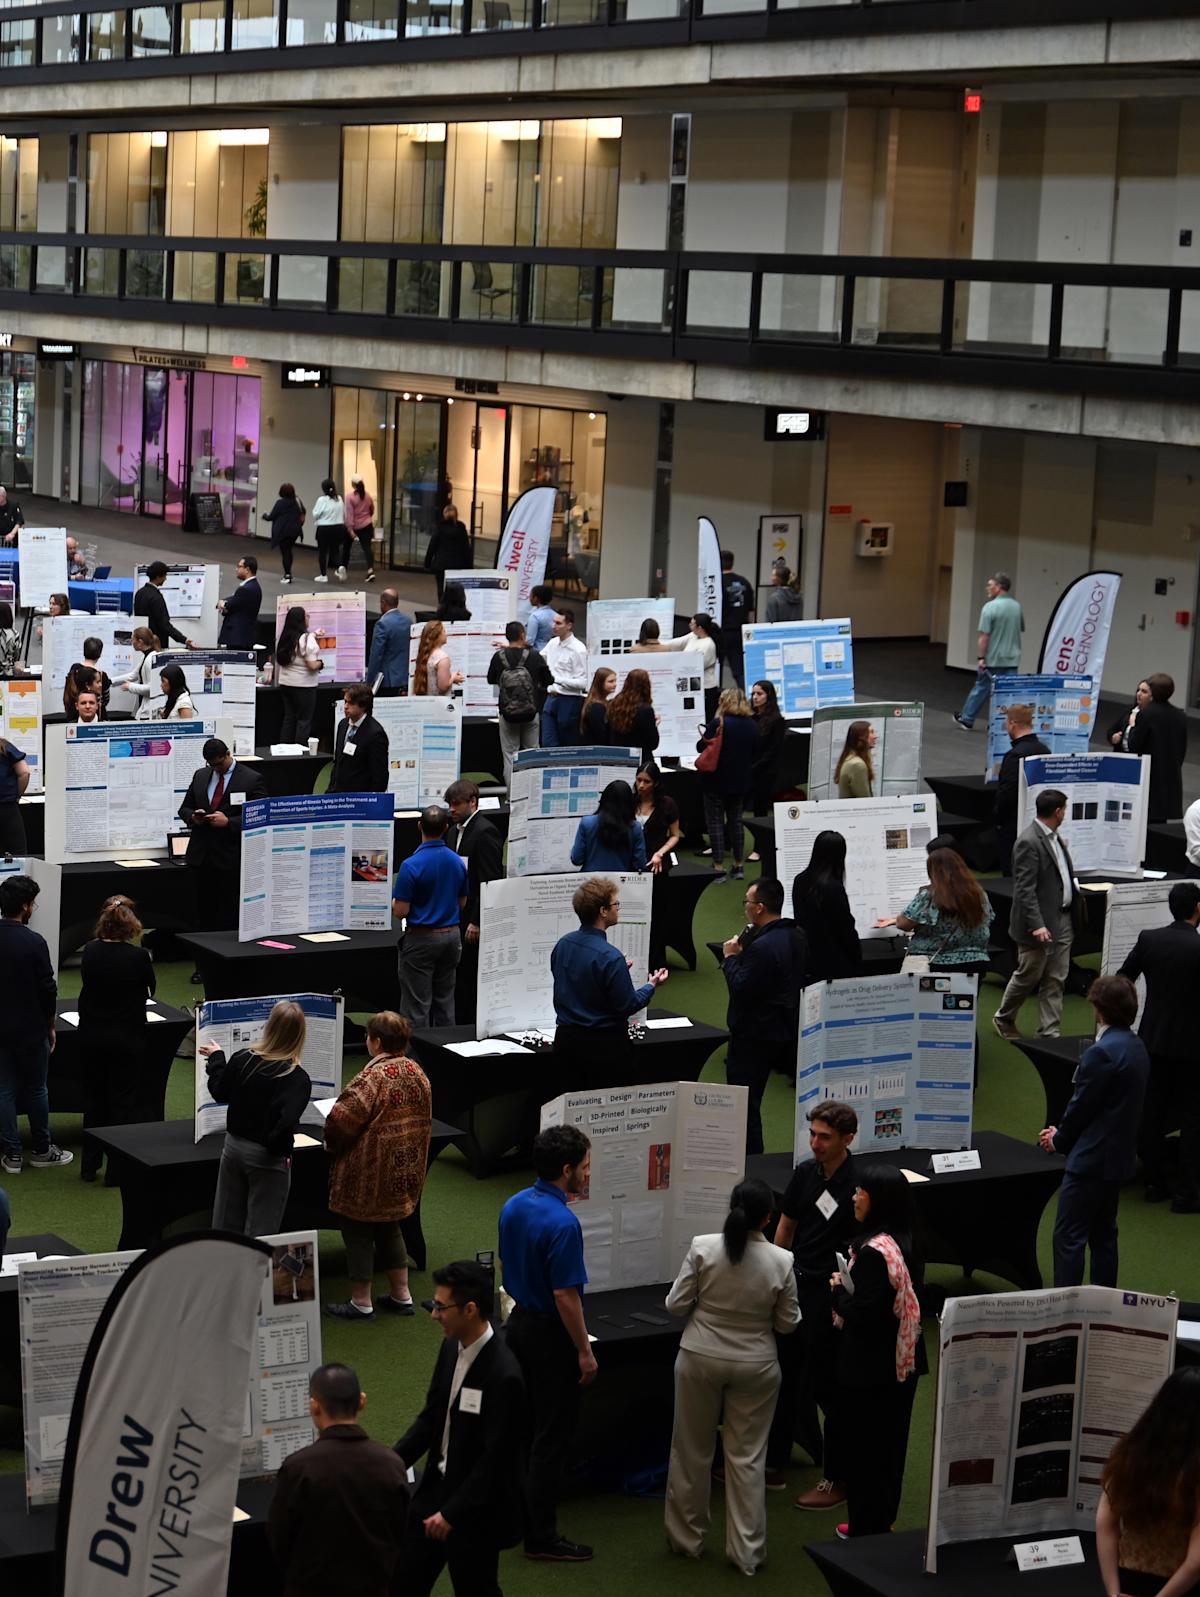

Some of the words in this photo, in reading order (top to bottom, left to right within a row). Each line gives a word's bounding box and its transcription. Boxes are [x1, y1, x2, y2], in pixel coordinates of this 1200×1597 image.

[518, 538, 540, 600] UNIVERSITY
[1074, 581, 1106, 674] ECHNOLOGY
[1055, 636, 1075, 673] ens
[567, 1096, 602, 1108] Evaluating
[610, 1092, 632, 1103] Design
[638, 1089, 675, 1099] Parameters
[575, 1115, 582, 1123] of
[590, 1110, 625, 1120] 3D-Printed
[630, 1104, 667, 1116] Biologically
[592, 1125, 619, 1135] Inspired
[626, 1121, 650, 1132] Springs
[997, 1299, 1025, 1307] Powered
[1026, 1299, 1035, 1307] by
[1141, 1296, 1166, 1308] NYU
[89, 1414, 154, 1577] Drew
[148, 1407, 207, 1597] NIVERSITY
